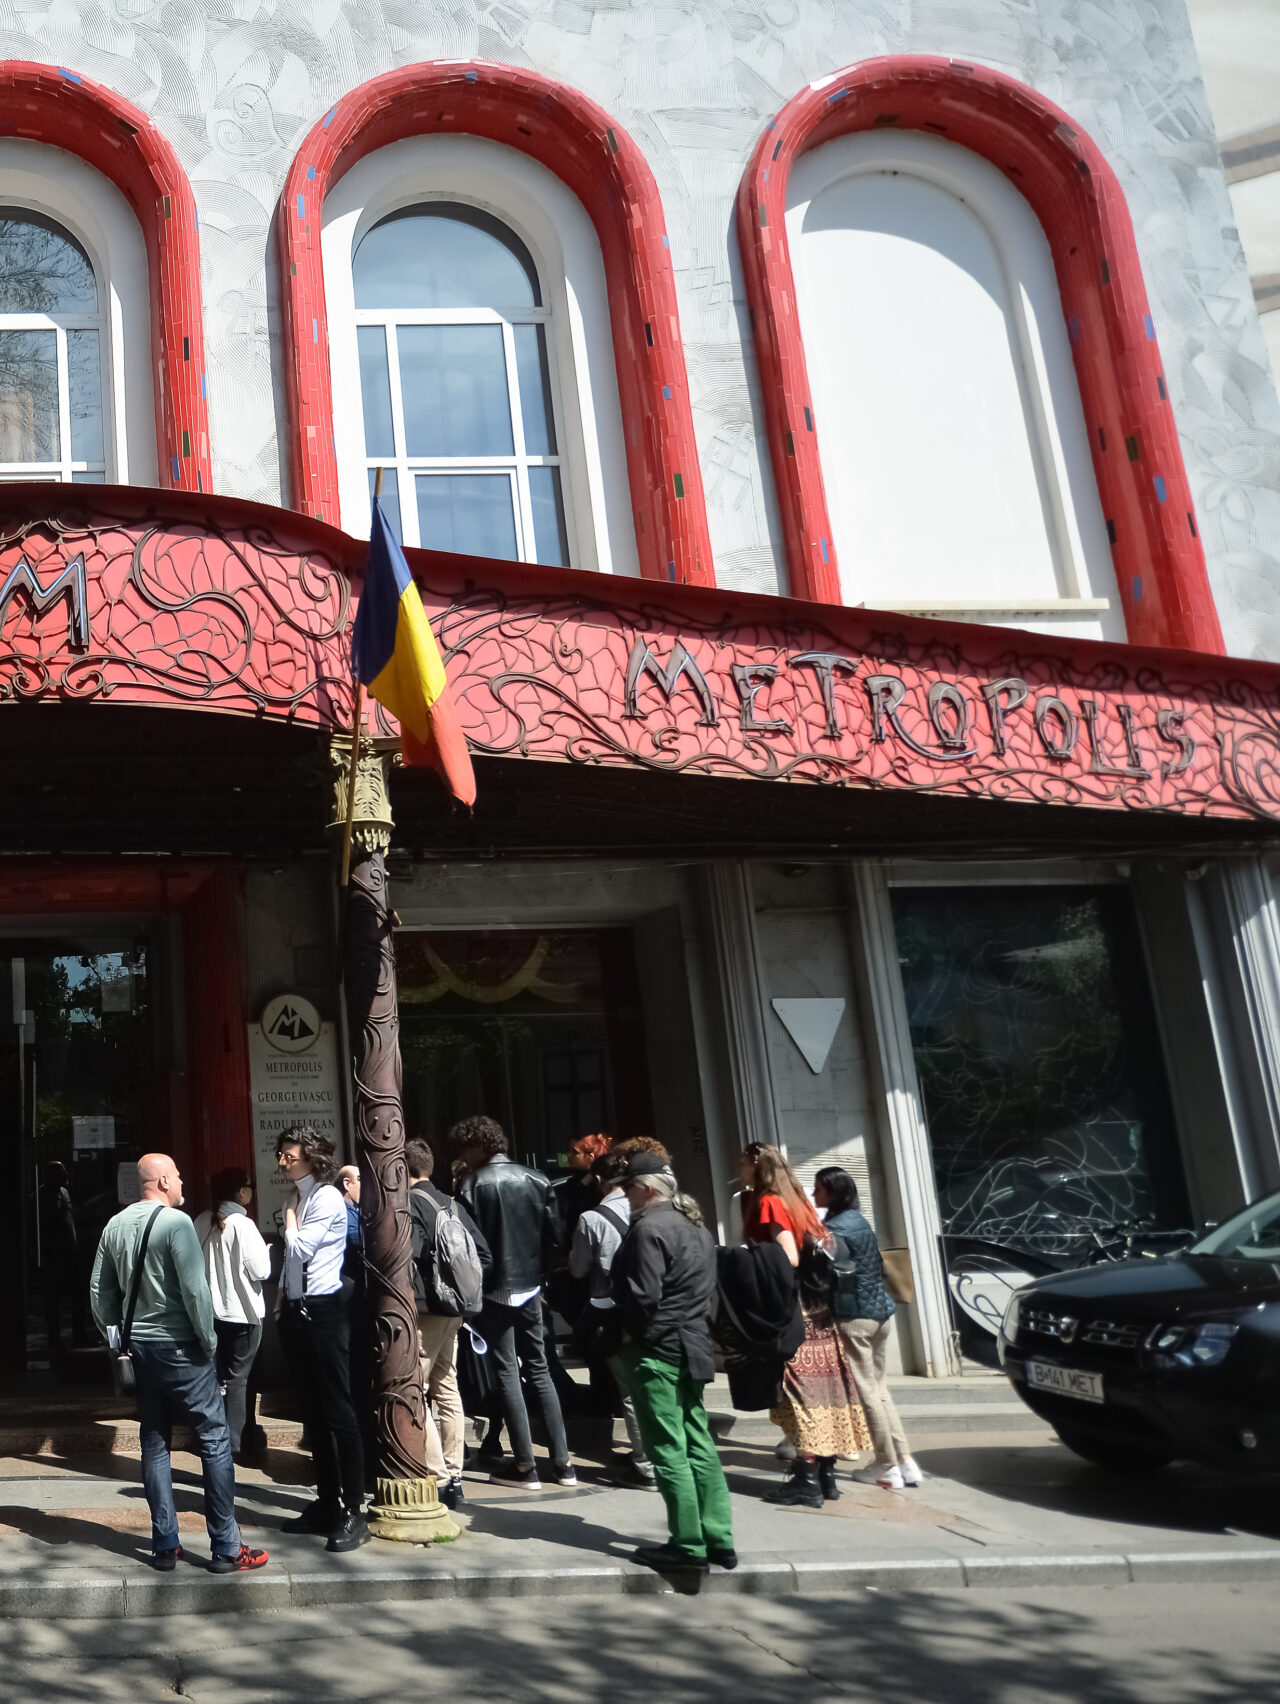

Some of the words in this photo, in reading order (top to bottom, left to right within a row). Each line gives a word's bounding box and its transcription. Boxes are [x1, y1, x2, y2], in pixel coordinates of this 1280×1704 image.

[621, 635, 1198, 780] METROPOLIS
[265, 1061, 323, 1073] METROPOLIS
[258, 1091, 296, 1103] GEORGE
[260, 1119, 288, 1130] RADU
